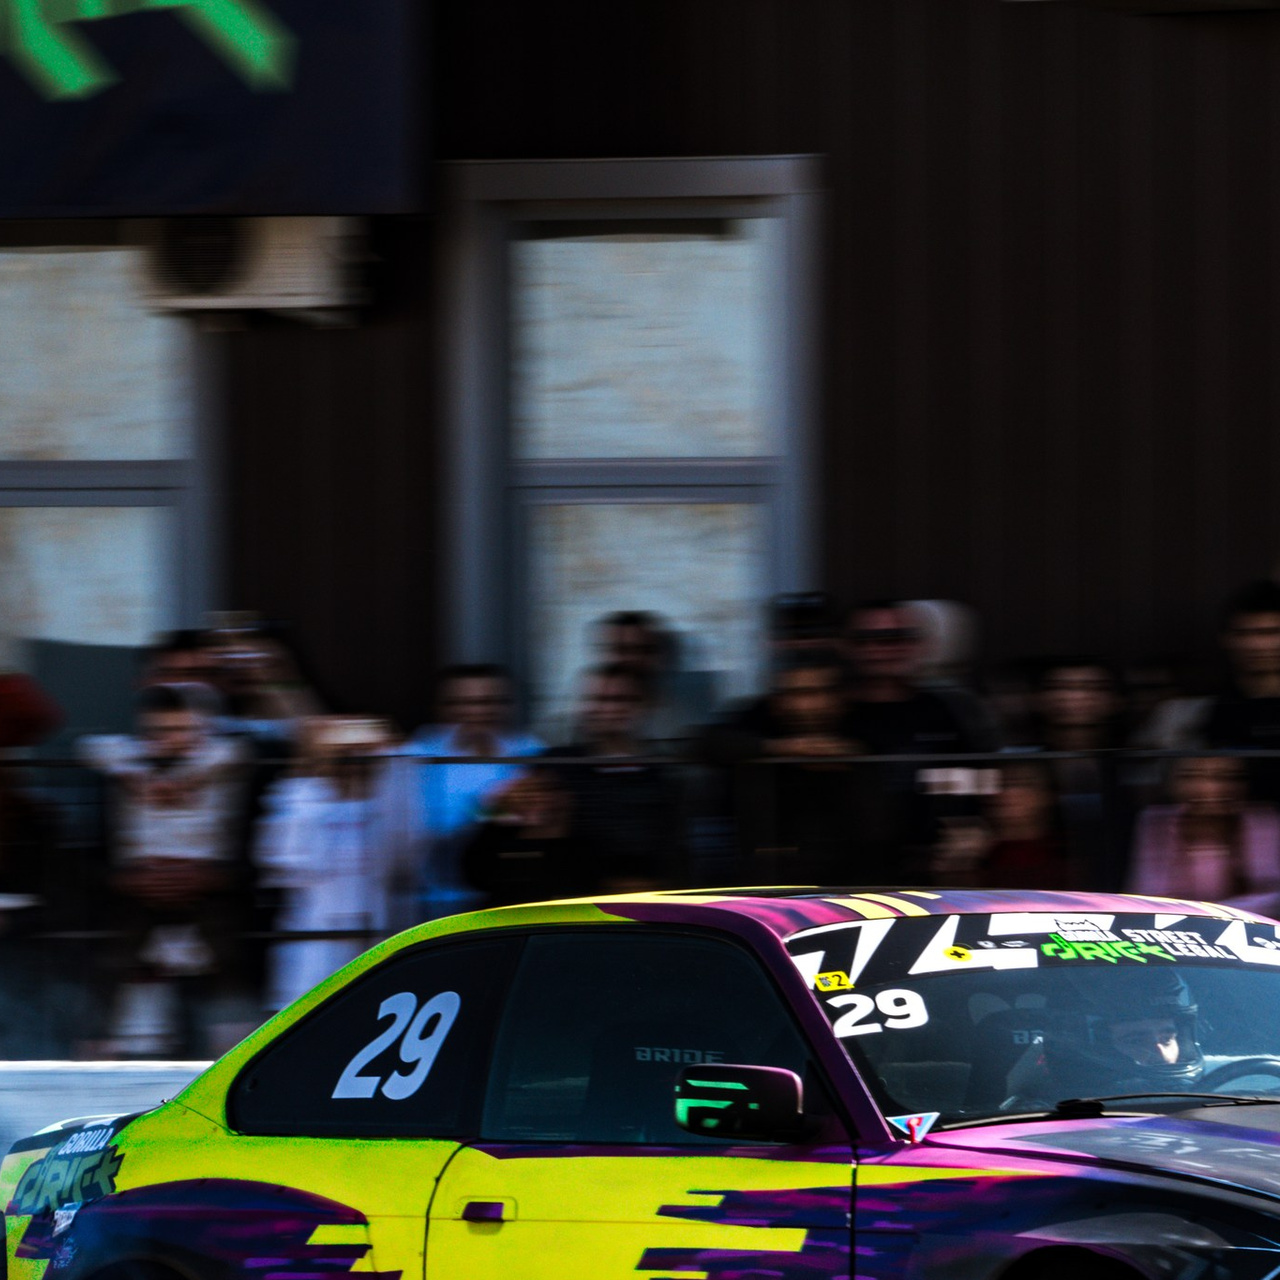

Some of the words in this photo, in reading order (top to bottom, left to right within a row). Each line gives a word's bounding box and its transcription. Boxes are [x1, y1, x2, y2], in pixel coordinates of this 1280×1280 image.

[1121, 928, 1208, 945] STREET
[1160, 942, 1239, 960] LEGAL
[831, 974, 847, 987] 2
[826, 988, 930, 1038] 29
[331, 990, 462, 1100] 29
[634, 1046, 725, 1064] BRIDE
[57, 1127, 115, 1156] GORILLA
